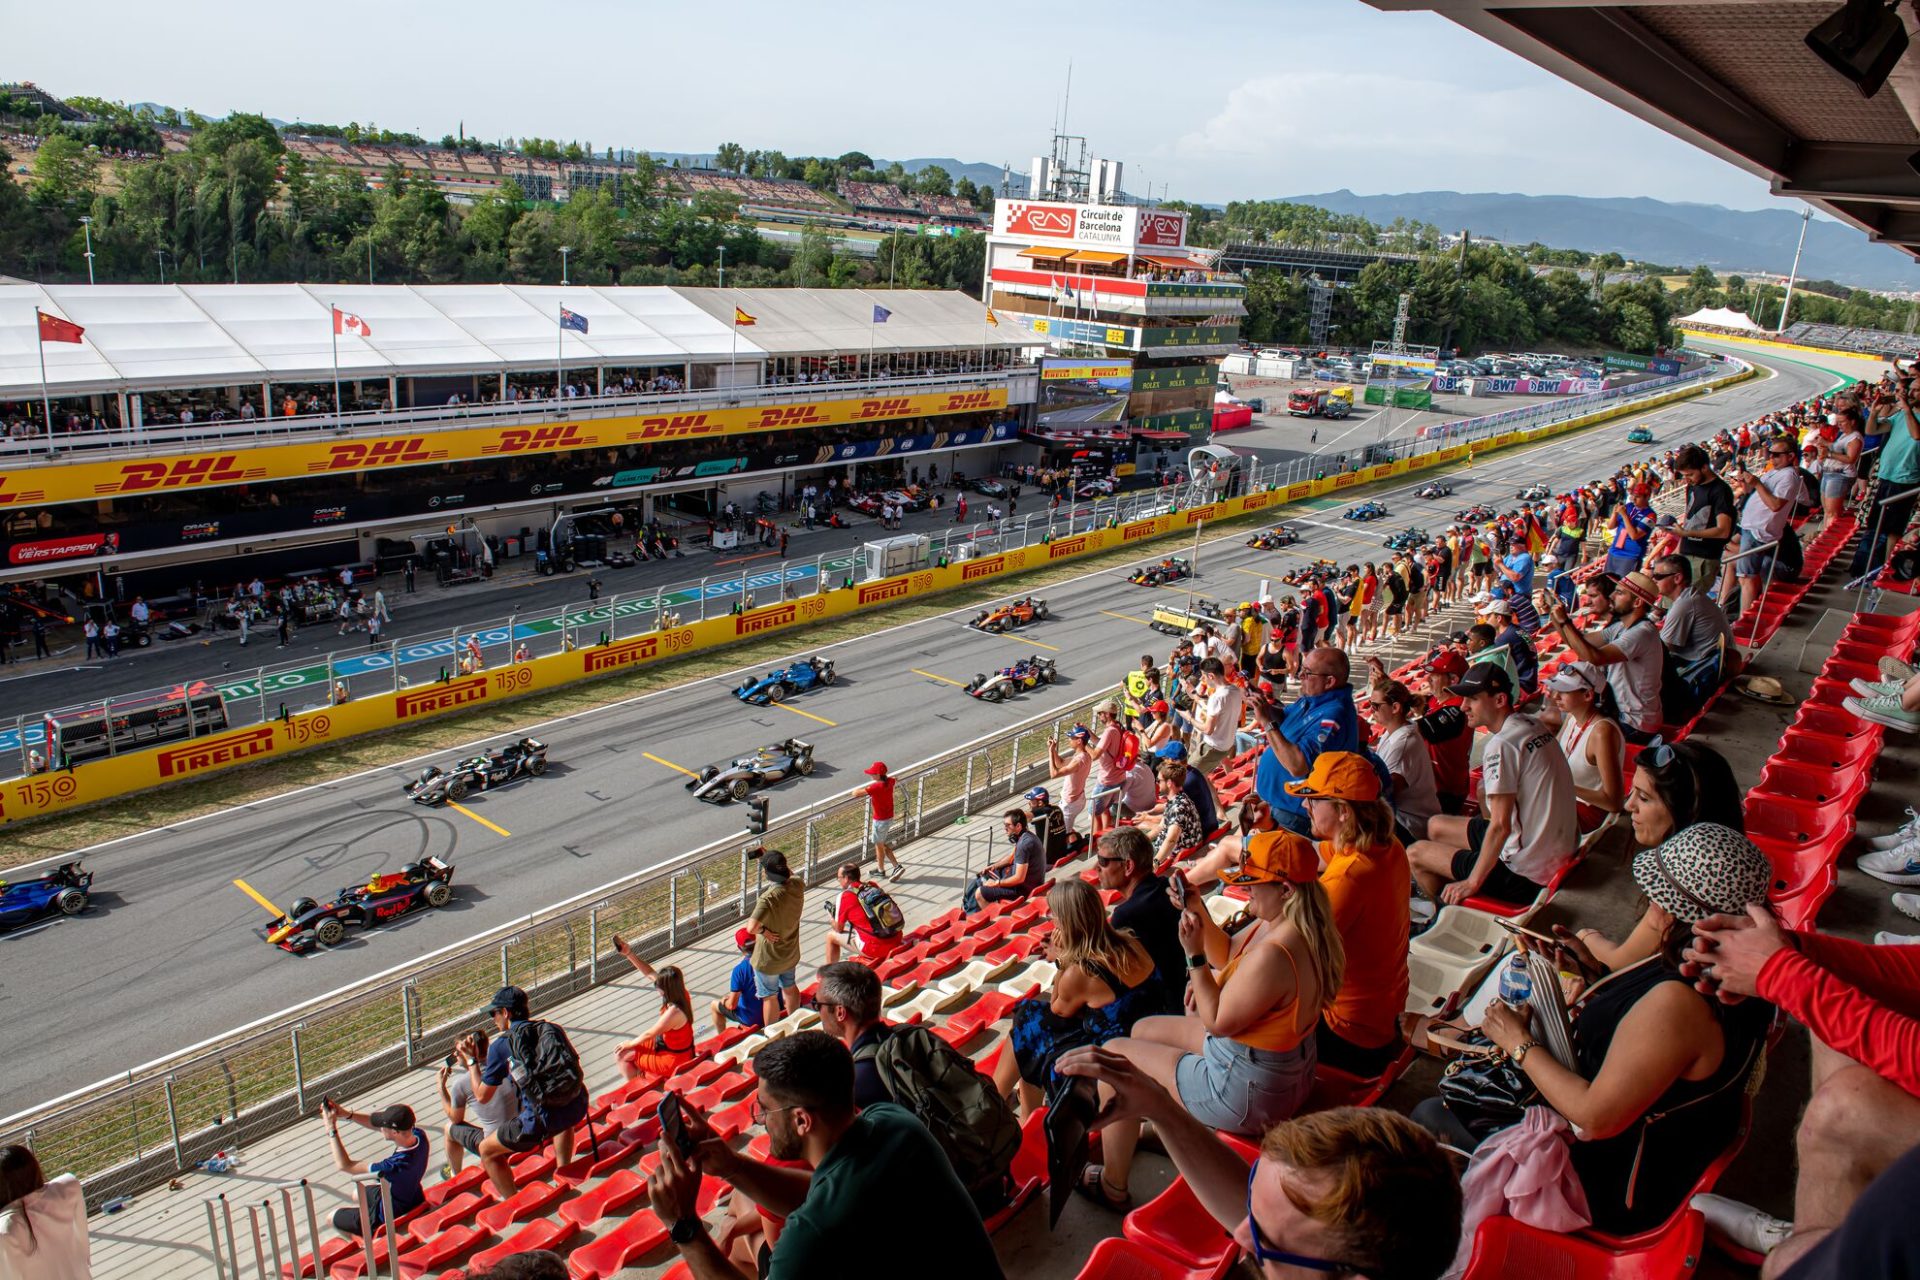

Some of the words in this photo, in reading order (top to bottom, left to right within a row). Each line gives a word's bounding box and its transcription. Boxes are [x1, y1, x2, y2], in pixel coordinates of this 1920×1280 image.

[1081, 209, 1111, 220] Circuit
[1111, 212, 1123, 221] de
[1079, 220, 1121, 233] Barcelona
[1079, 232, 1121, 243] CATALUNYA
[1607, 356, 1645, 369] Heineken
[1493, 378, 1517, 393] BWT
[1537, 379, 1560, 393] BWT
[860, 398, 914, 418] DHL
[947, 391, 993, 410] DHL
[640, 415, 711, 439] DHL
[759, 406, 820, 428] DHL
[499, 425, 585, 452] DHL
[328, 438, 431, 469] DHL
[120, 456, 245, 491] DHL
[1187, 506, 1215, 524] PIRELLI
[1124, 521, 1155, 540] PIRELLI
[18, 543, 97, 559] VERSTAPPEN
[1050, 537, 1086, 558] PIRELLI
[962, 557, 1005, 580] PIRELLI
[705, 568, 805, 595] aramco
[858, 578, 909, 604] PIRELLI
[913, 573, 933, 590] 150
[552, 593, 672, 626] aramco
[736, 604, 797, 635] PIRELLI
[801, 598, 826, 618] 150
[363, 628, 510, 667] aamo
[584, 637, 658, 672] PIRELLI
[664, 629, 694, 651] 150
[396, 677, 488, 719] PIRELLI
[496, 667, 532, 692] 150
[157, 727, 274, 777] PIRELLI
[283, 715, 331, 743] 150
[17, 776, 77, 808] 150
[376, 905, 394, 917] Red
